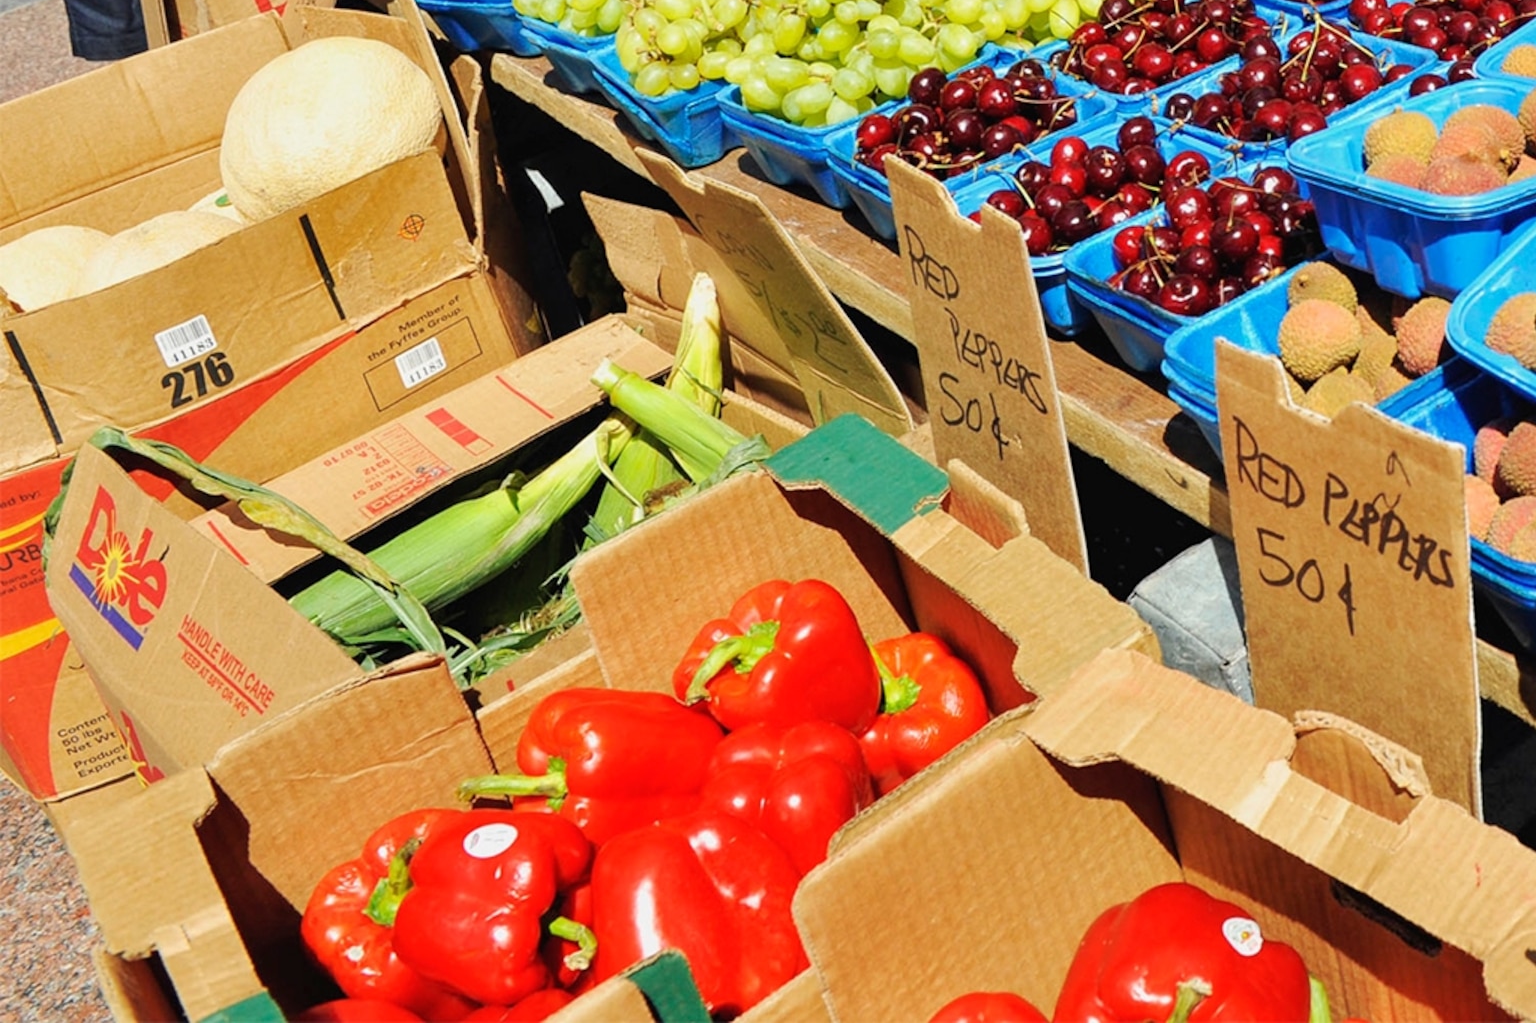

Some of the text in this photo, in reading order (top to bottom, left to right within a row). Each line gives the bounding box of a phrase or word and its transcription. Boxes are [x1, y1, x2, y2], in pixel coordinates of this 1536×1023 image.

[904, 224, 960, 302] RED
[398, 294, 460, 333] Member of
[367, 347, 387, 361] the
[388, 326, 425, 350] Fyffes
[944, 307, 1048, 414] PEPPERS
[161, 352, 234, 409] 276
[1233, 415, 1455, 588] RED PEPPERS
[76, 484, 168, 626] Dole
[181, 614, 275, 709] HANDLE WITH CARE
[182, 651, 201, 670] KEEP
[198, 666, 210, 679] AT
[221, 686, 235, 704] OR
[62, 727, 103, 747] 50 lbs
[67, 731, 117, 756] Net Wt
